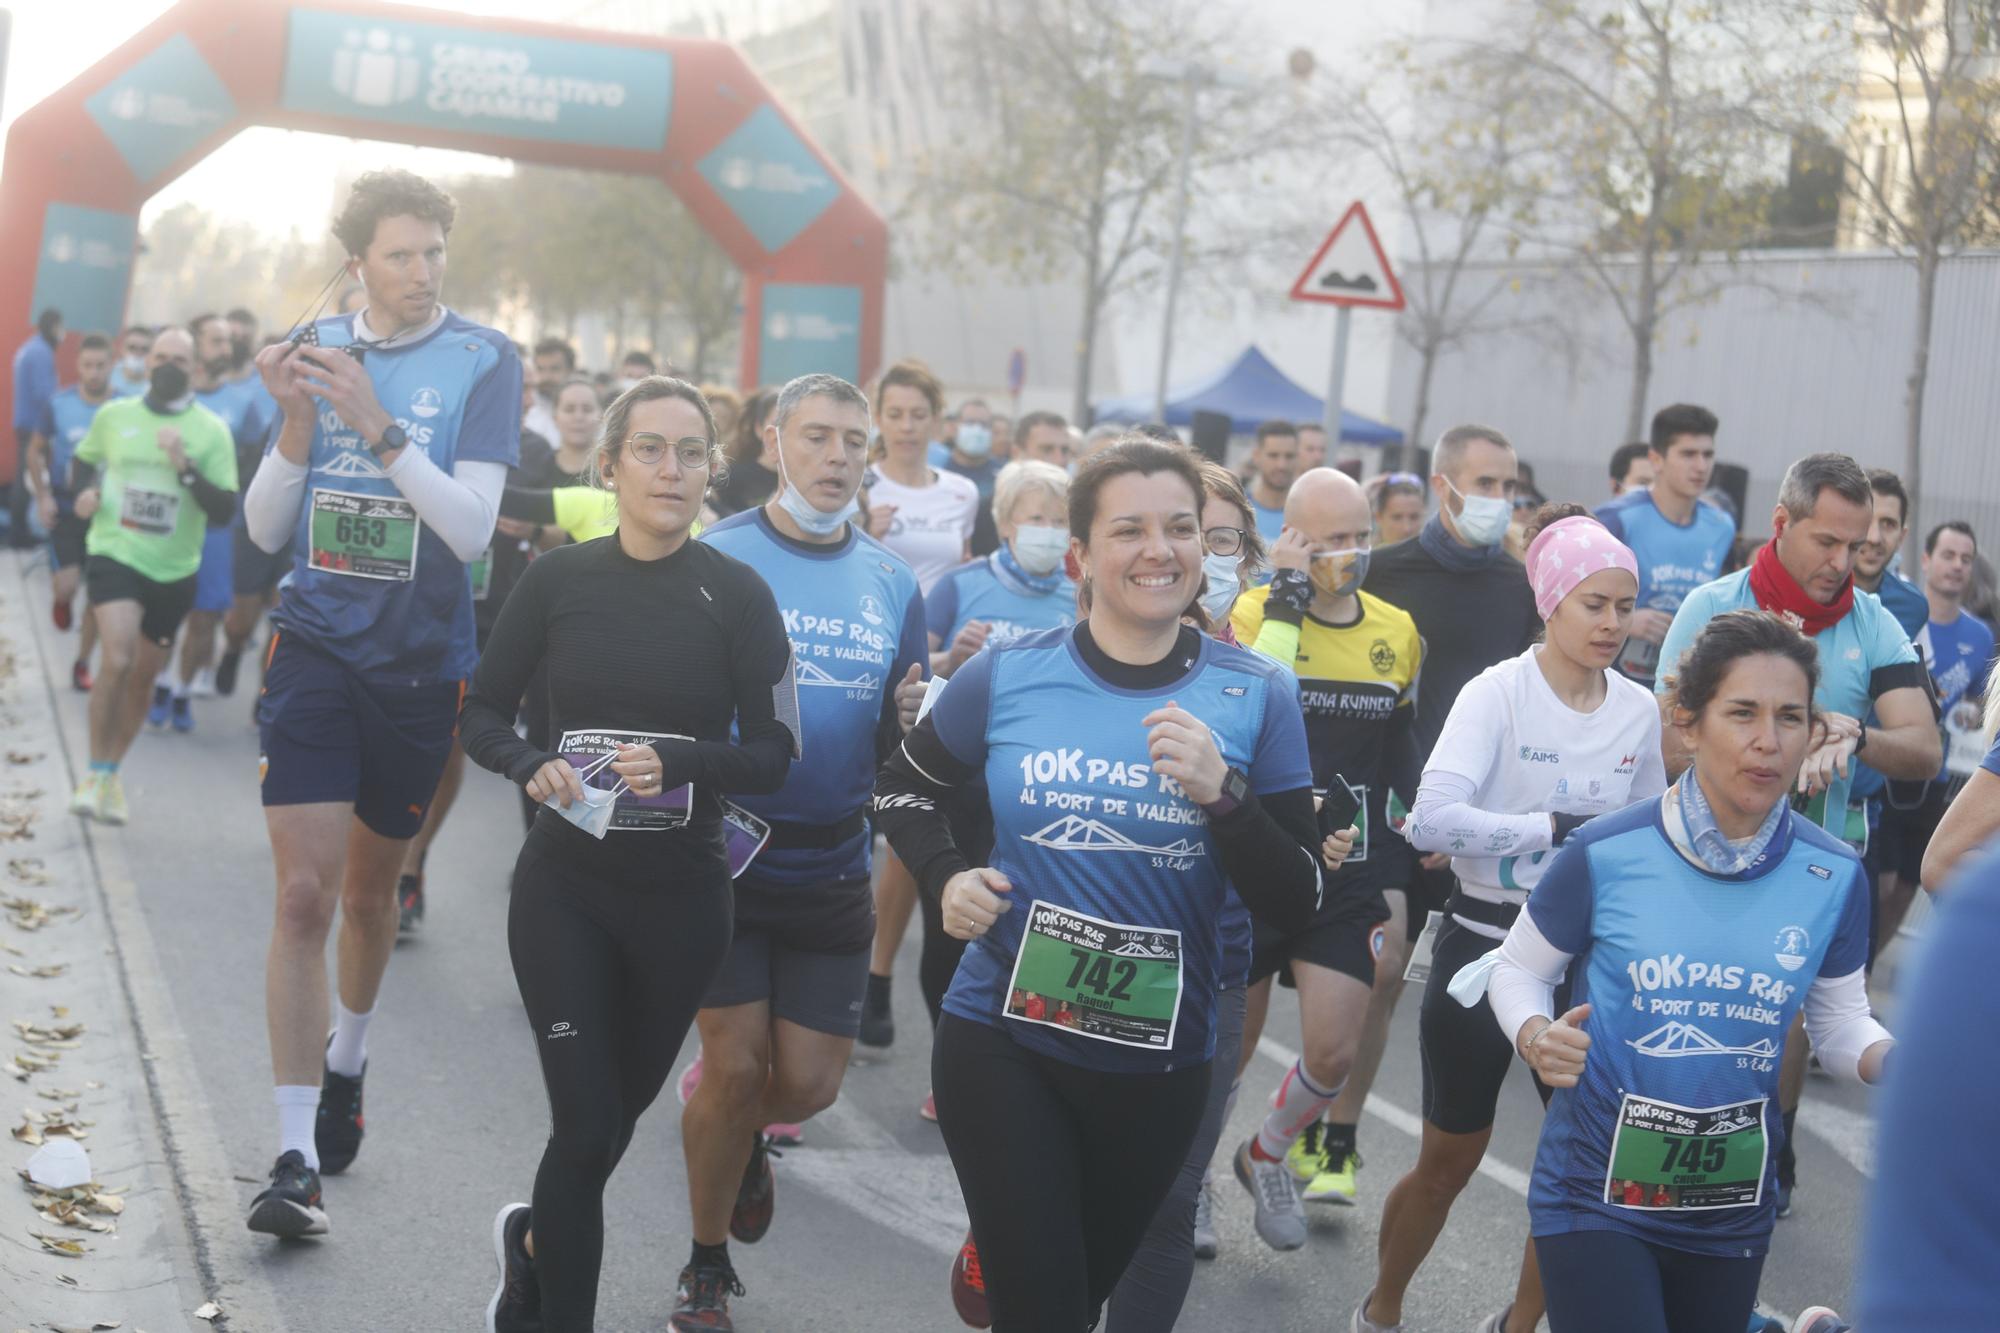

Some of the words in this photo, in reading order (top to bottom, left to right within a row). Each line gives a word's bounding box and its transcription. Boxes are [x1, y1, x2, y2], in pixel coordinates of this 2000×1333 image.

[429, 64, 625, 107] COOPERATIVO
[335, 515, 386, 548] 653
[801, 615, 844, 637] PAS
[849, 623, 884, 651] RAS
[813, 644, 830, 657] DE
[565, 734, 583, 748] 10K
[583, 735, 602, 745] PAS
[1020, 747, 1084, 786] 10K
[1086, 758, 1150, 788] PAS
[1530, 752, 1559, 764] AIMS
[1020, 785, 1037, 805] AL
[1045, 790, 1095, 811] PORT
[1103, 798, 1127, 816] DE
[1035, 910, 1060, 926] 10K
[1059, 916, 1083, 932] PAS
[1083, 925, 1107, 943] RAS
[1043, 926, 1062, 938] PORT
[1062, 932, 1072, 942] DE
[1065, 948, 1138, 1001] 742
[1627, 953, 1686, 992] 10K
[1687, 962, 1745, 990] PAS
[1748, 972, 1796, 1005] RAS
[1076, 992, 1114, 1011] Raquel
[1650, 998, 1693, 1017] PORT
[1697, 1001, 1720, 1017] DE
[1725, 1001, 1781, 1026] VALÈNC
[1627, 1103, 1651, 1118] 10K
[1650, 1108, 1675, 1121] PAS
[1675, 1115, 1698, 1129] RAS
[1660, 1136, 1728, 1174] 745
